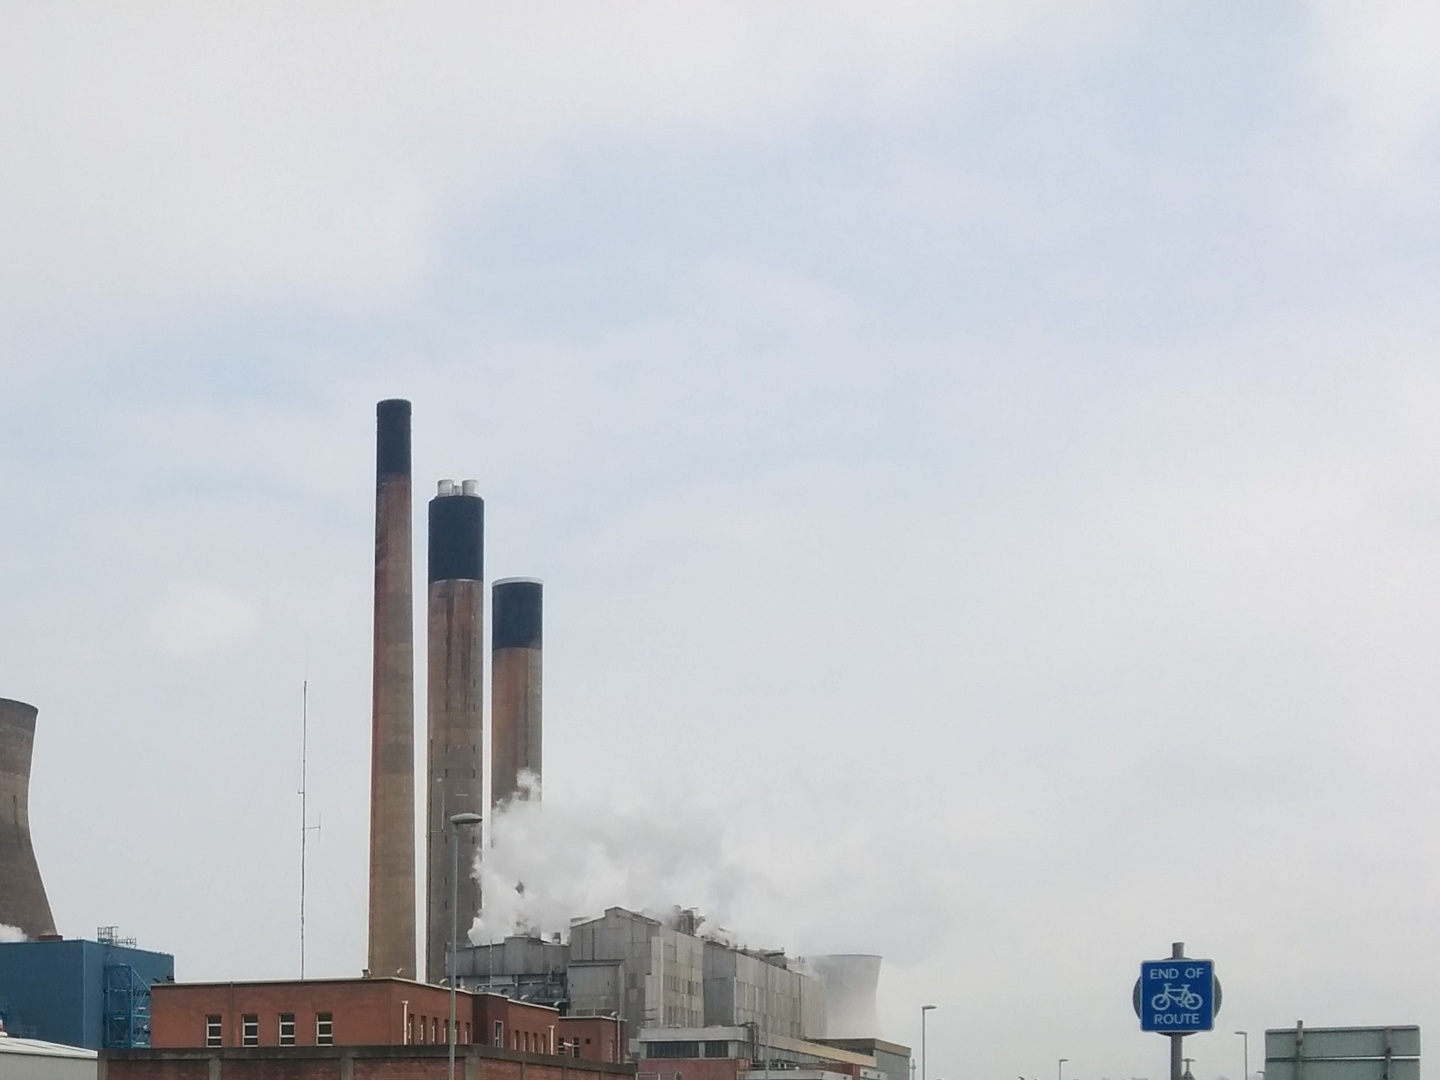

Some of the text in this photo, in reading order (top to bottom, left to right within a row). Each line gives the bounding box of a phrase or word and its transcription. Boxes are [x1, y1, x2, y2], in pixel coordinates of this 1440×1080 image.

[1150, 967, 1205, 979] END OF
[1154, 1013, 1200, 1025] ROUTE
